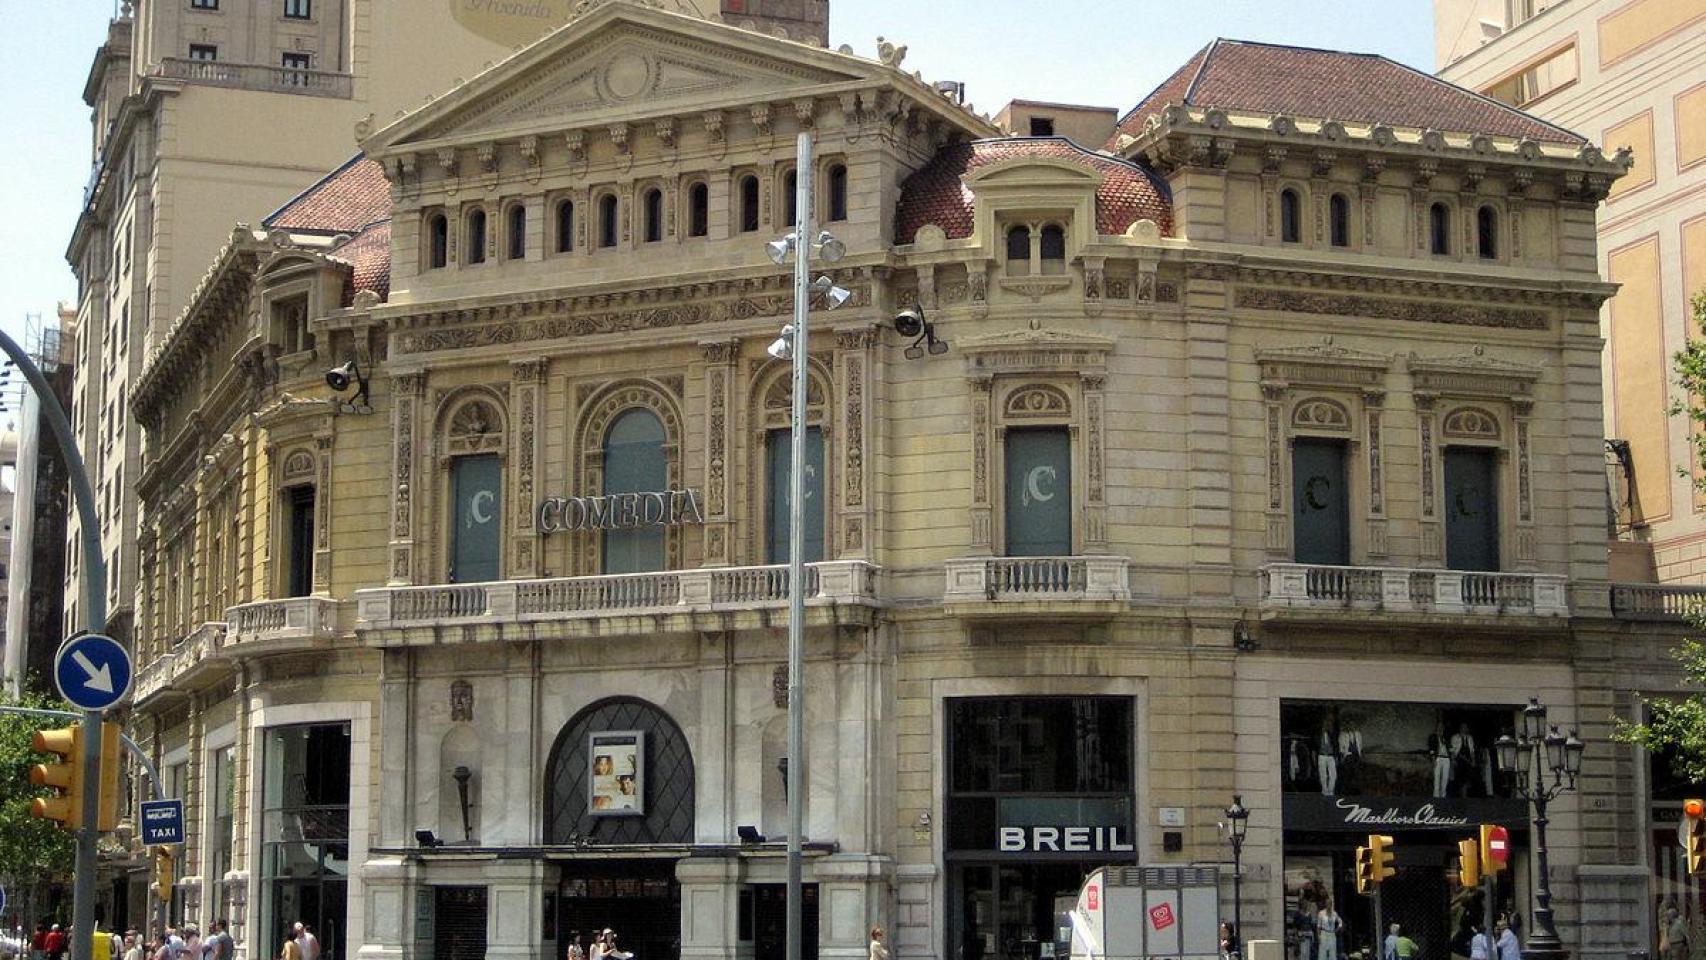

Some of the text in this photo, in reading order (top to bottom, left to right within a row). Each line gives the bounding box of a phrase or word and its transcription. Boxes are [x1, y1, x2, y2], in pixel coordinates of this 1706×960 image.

[537, 488, 704, 533] COMEDIA
[1335, 798, 1468, 825] Marlboro Classics
[150, 827, 176, 838] TAXI
[1000, 827, 1134, 852] BREIL
